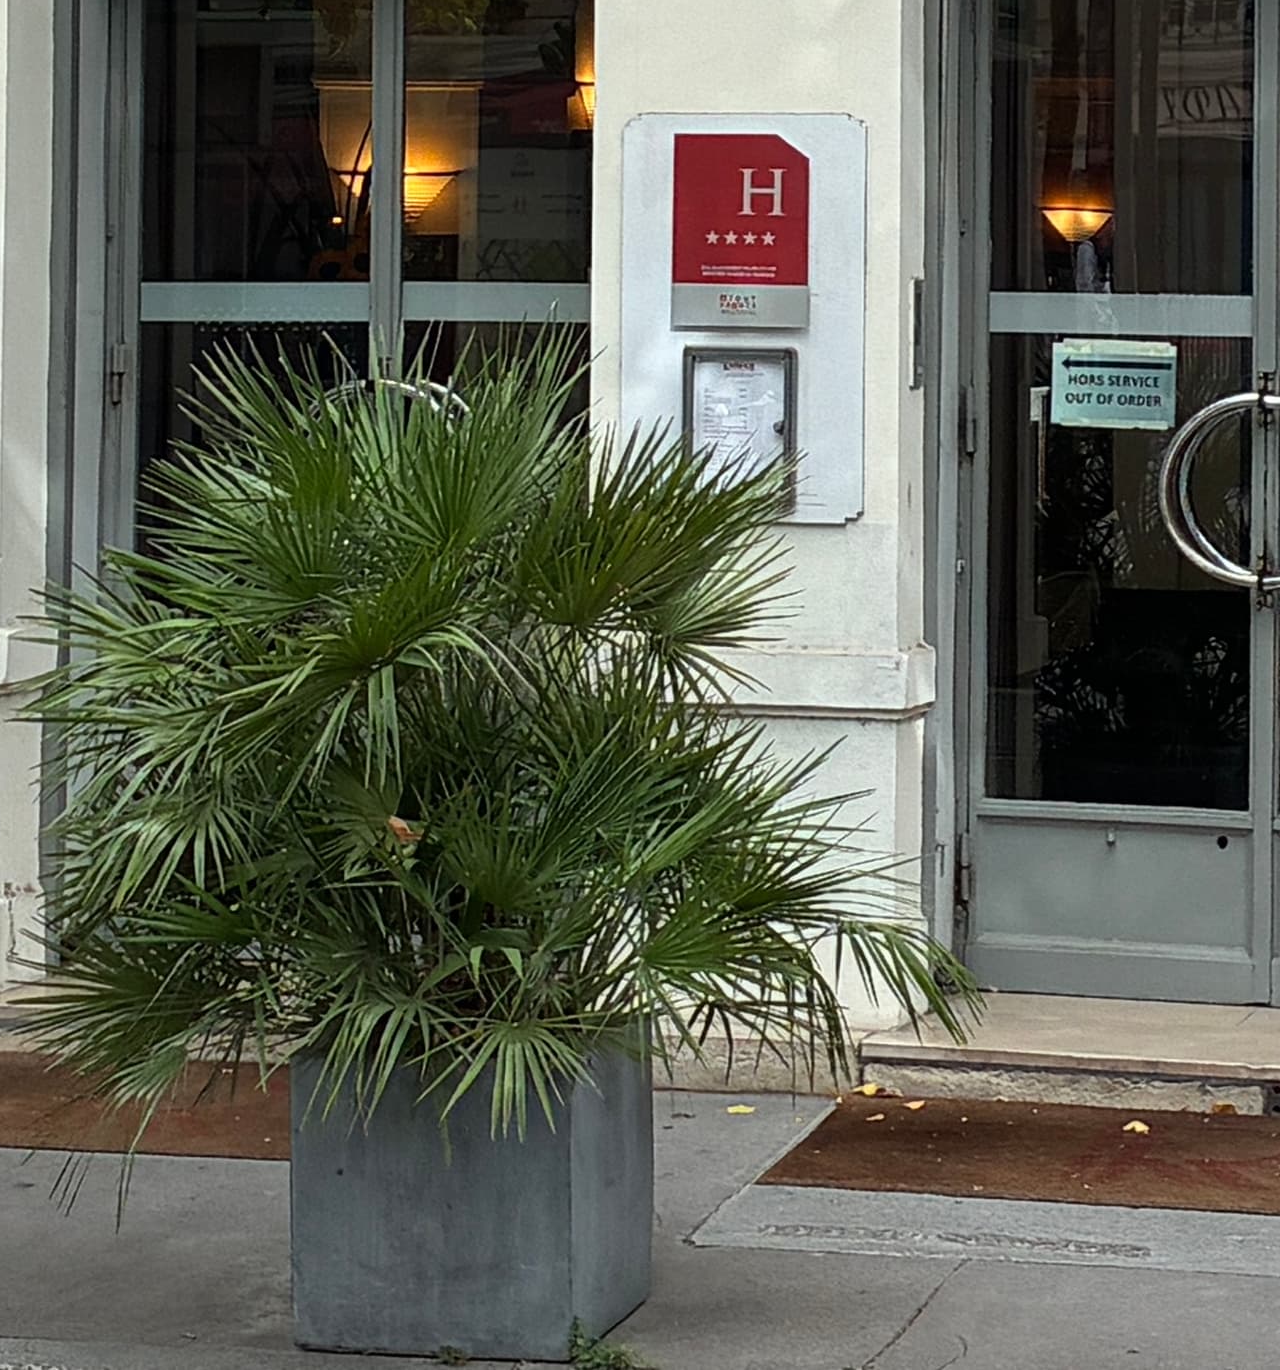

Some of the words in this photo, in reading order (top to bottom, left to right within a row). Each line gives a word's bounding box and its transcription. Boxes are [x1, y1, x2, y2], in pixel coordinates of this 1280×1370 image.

[737, 167, 788, 217] H
[1068, 373, 1105, 387] HORS
[1108, 374, 1160, 389] SERVICE
[1065, 392, 1092, 405] OUT
[1096, 393, 1113, 406] OF
[1117, 393, 1162, 407] ORDER
